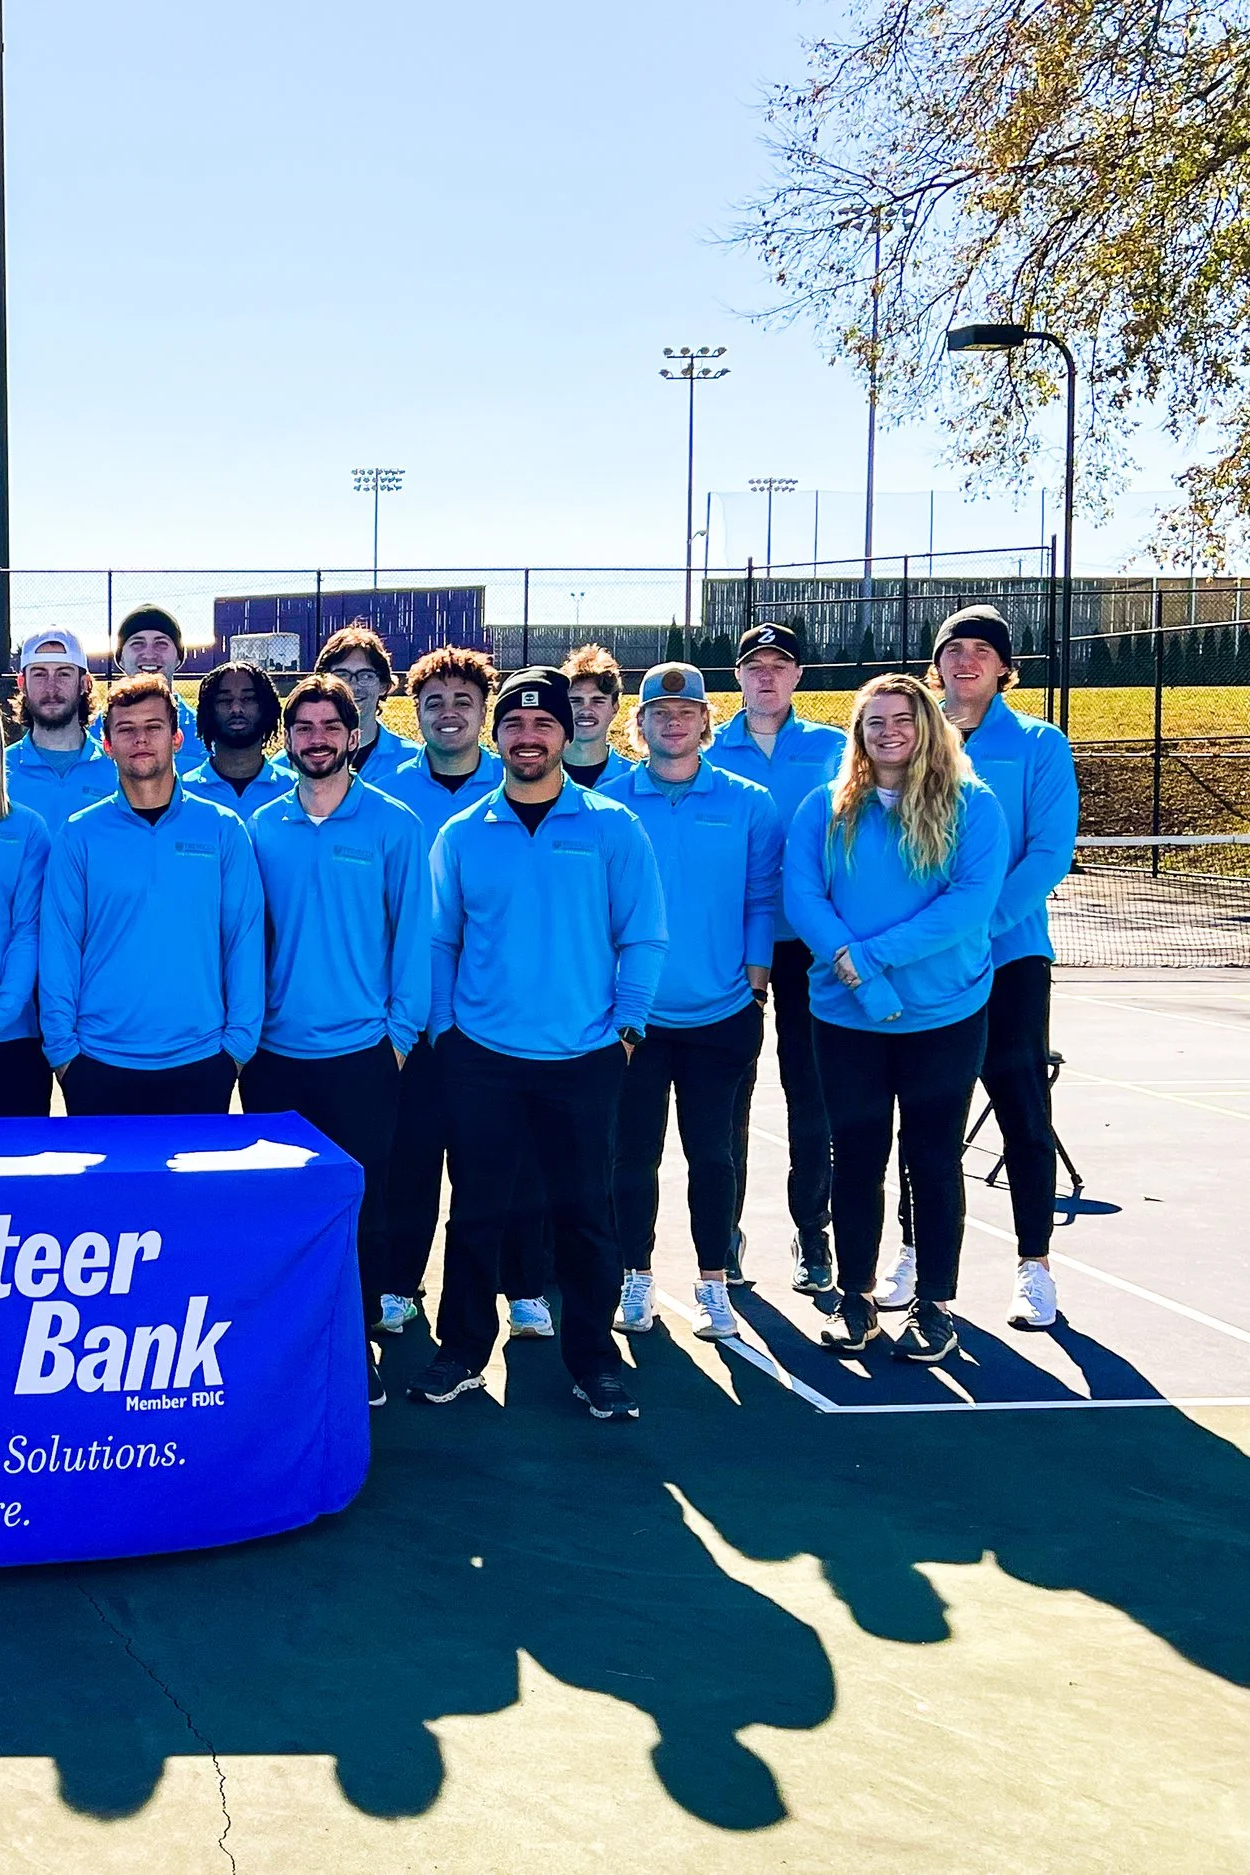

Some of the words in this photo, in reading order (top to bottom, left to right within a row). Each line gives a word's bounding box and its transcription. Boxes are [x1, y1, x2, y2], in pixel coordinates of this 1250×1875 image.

[13, 1295, 232, 1395] Bank
[126, 1394, 188, 1412] Member
[191, 1390, 225, 1408] FDIC
[3, 1434, 186, 1474] Solutions.
